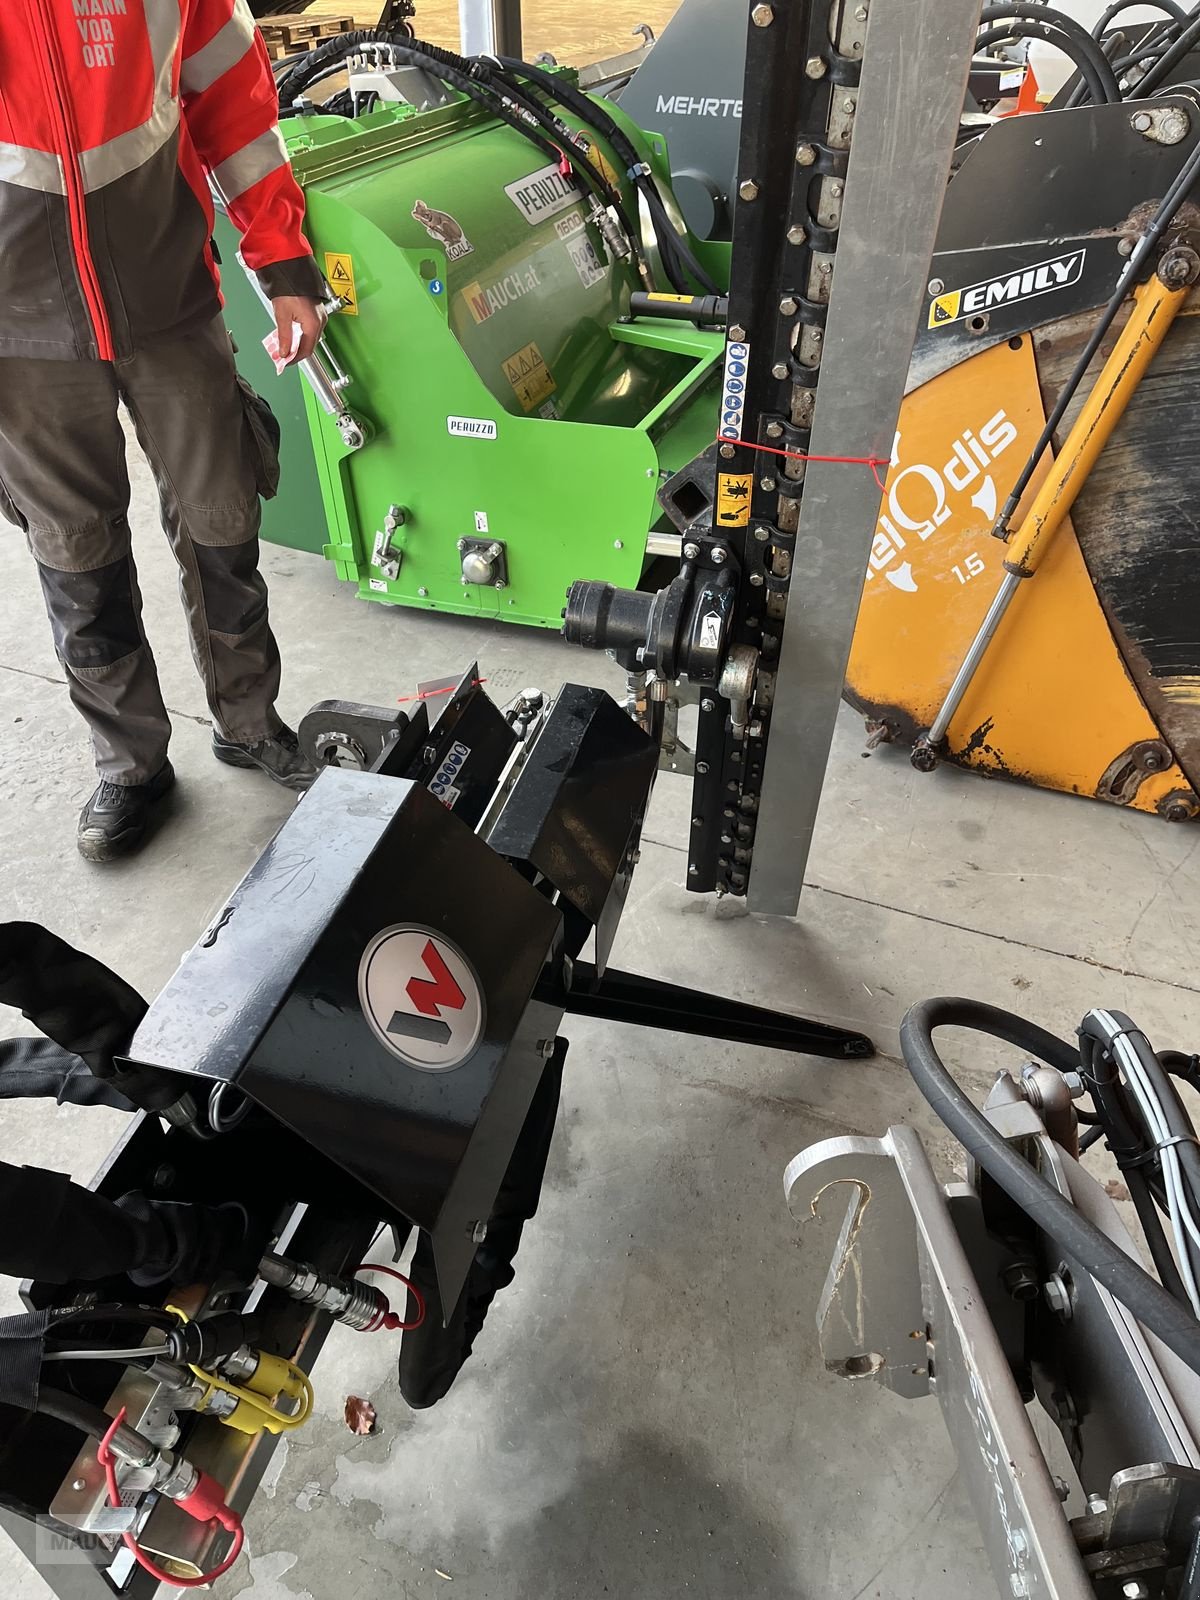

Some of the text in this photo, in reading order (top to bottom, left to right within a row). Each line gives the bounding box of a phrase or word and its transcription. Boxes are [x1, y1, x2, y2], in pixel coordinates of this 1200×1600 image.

[71, 0, 127, 16] MANN
[76, 18, 114, 43] VOR
[82, 43, 115, 68] ORT
[556, 213, 581, 237] 1600
[446, 240, 474, 260] KOALA
[471, 264, 541, 321] MAUCH.at
[963, 256, 1078, 313] EMILY
[450, 420, 494, 435] PERUZZO
[951, 551, 985, 585] 1.5
